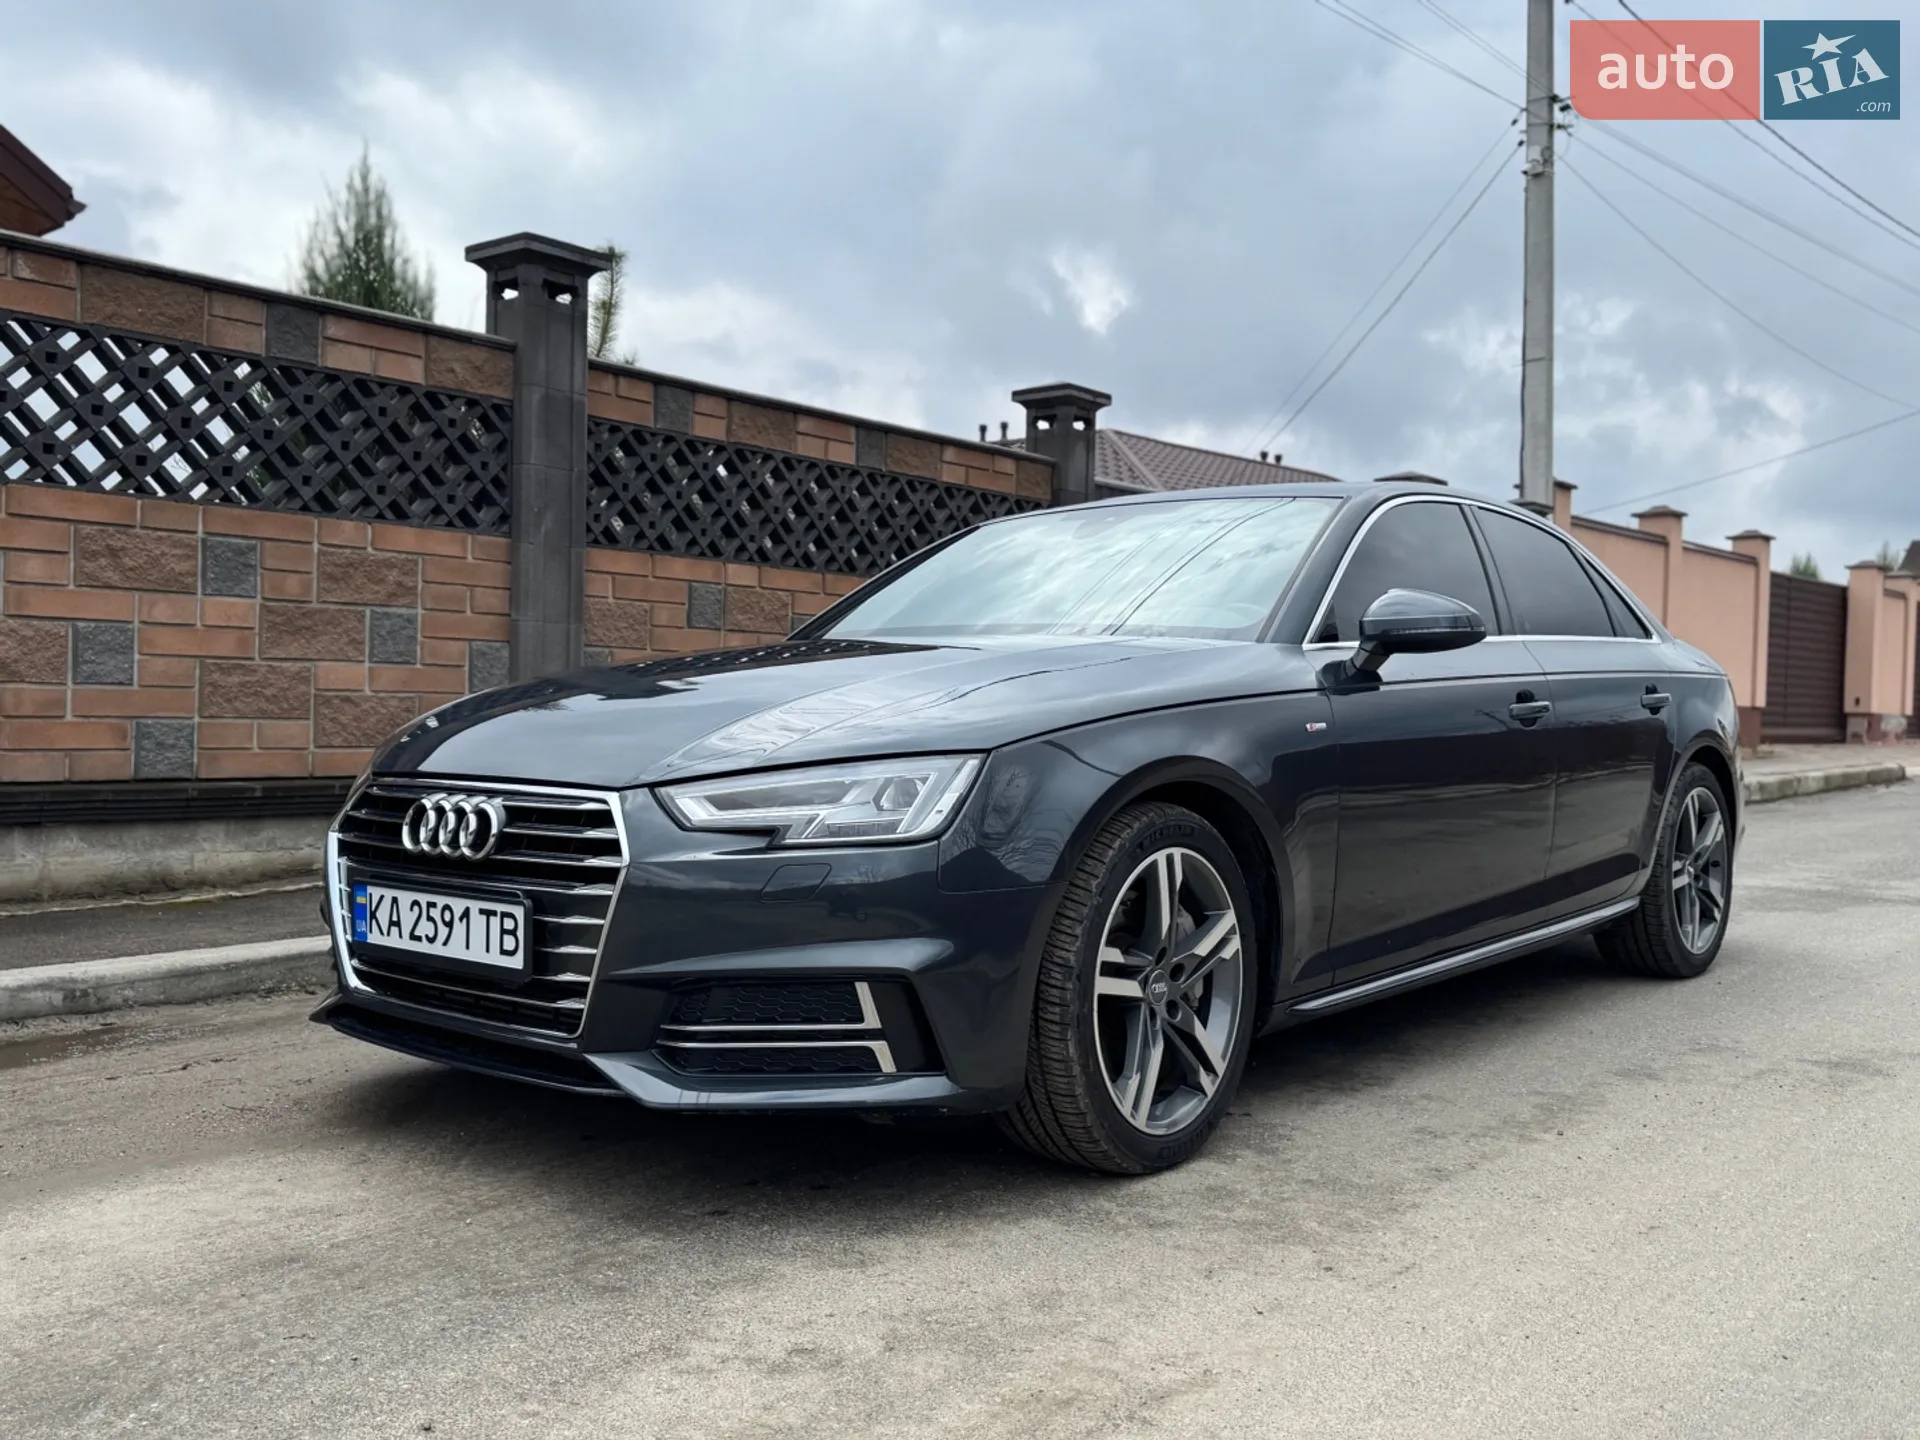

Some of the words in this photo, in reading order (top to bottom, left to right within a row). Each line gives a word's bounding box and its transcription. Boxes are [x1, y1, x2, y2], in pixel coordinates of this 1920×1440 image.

[356, 919, 367, 932] UA
[369, 892, 403, 940] KA
[409, 899, 470, 951] 2591
[478, 908, 519, 957] TB
